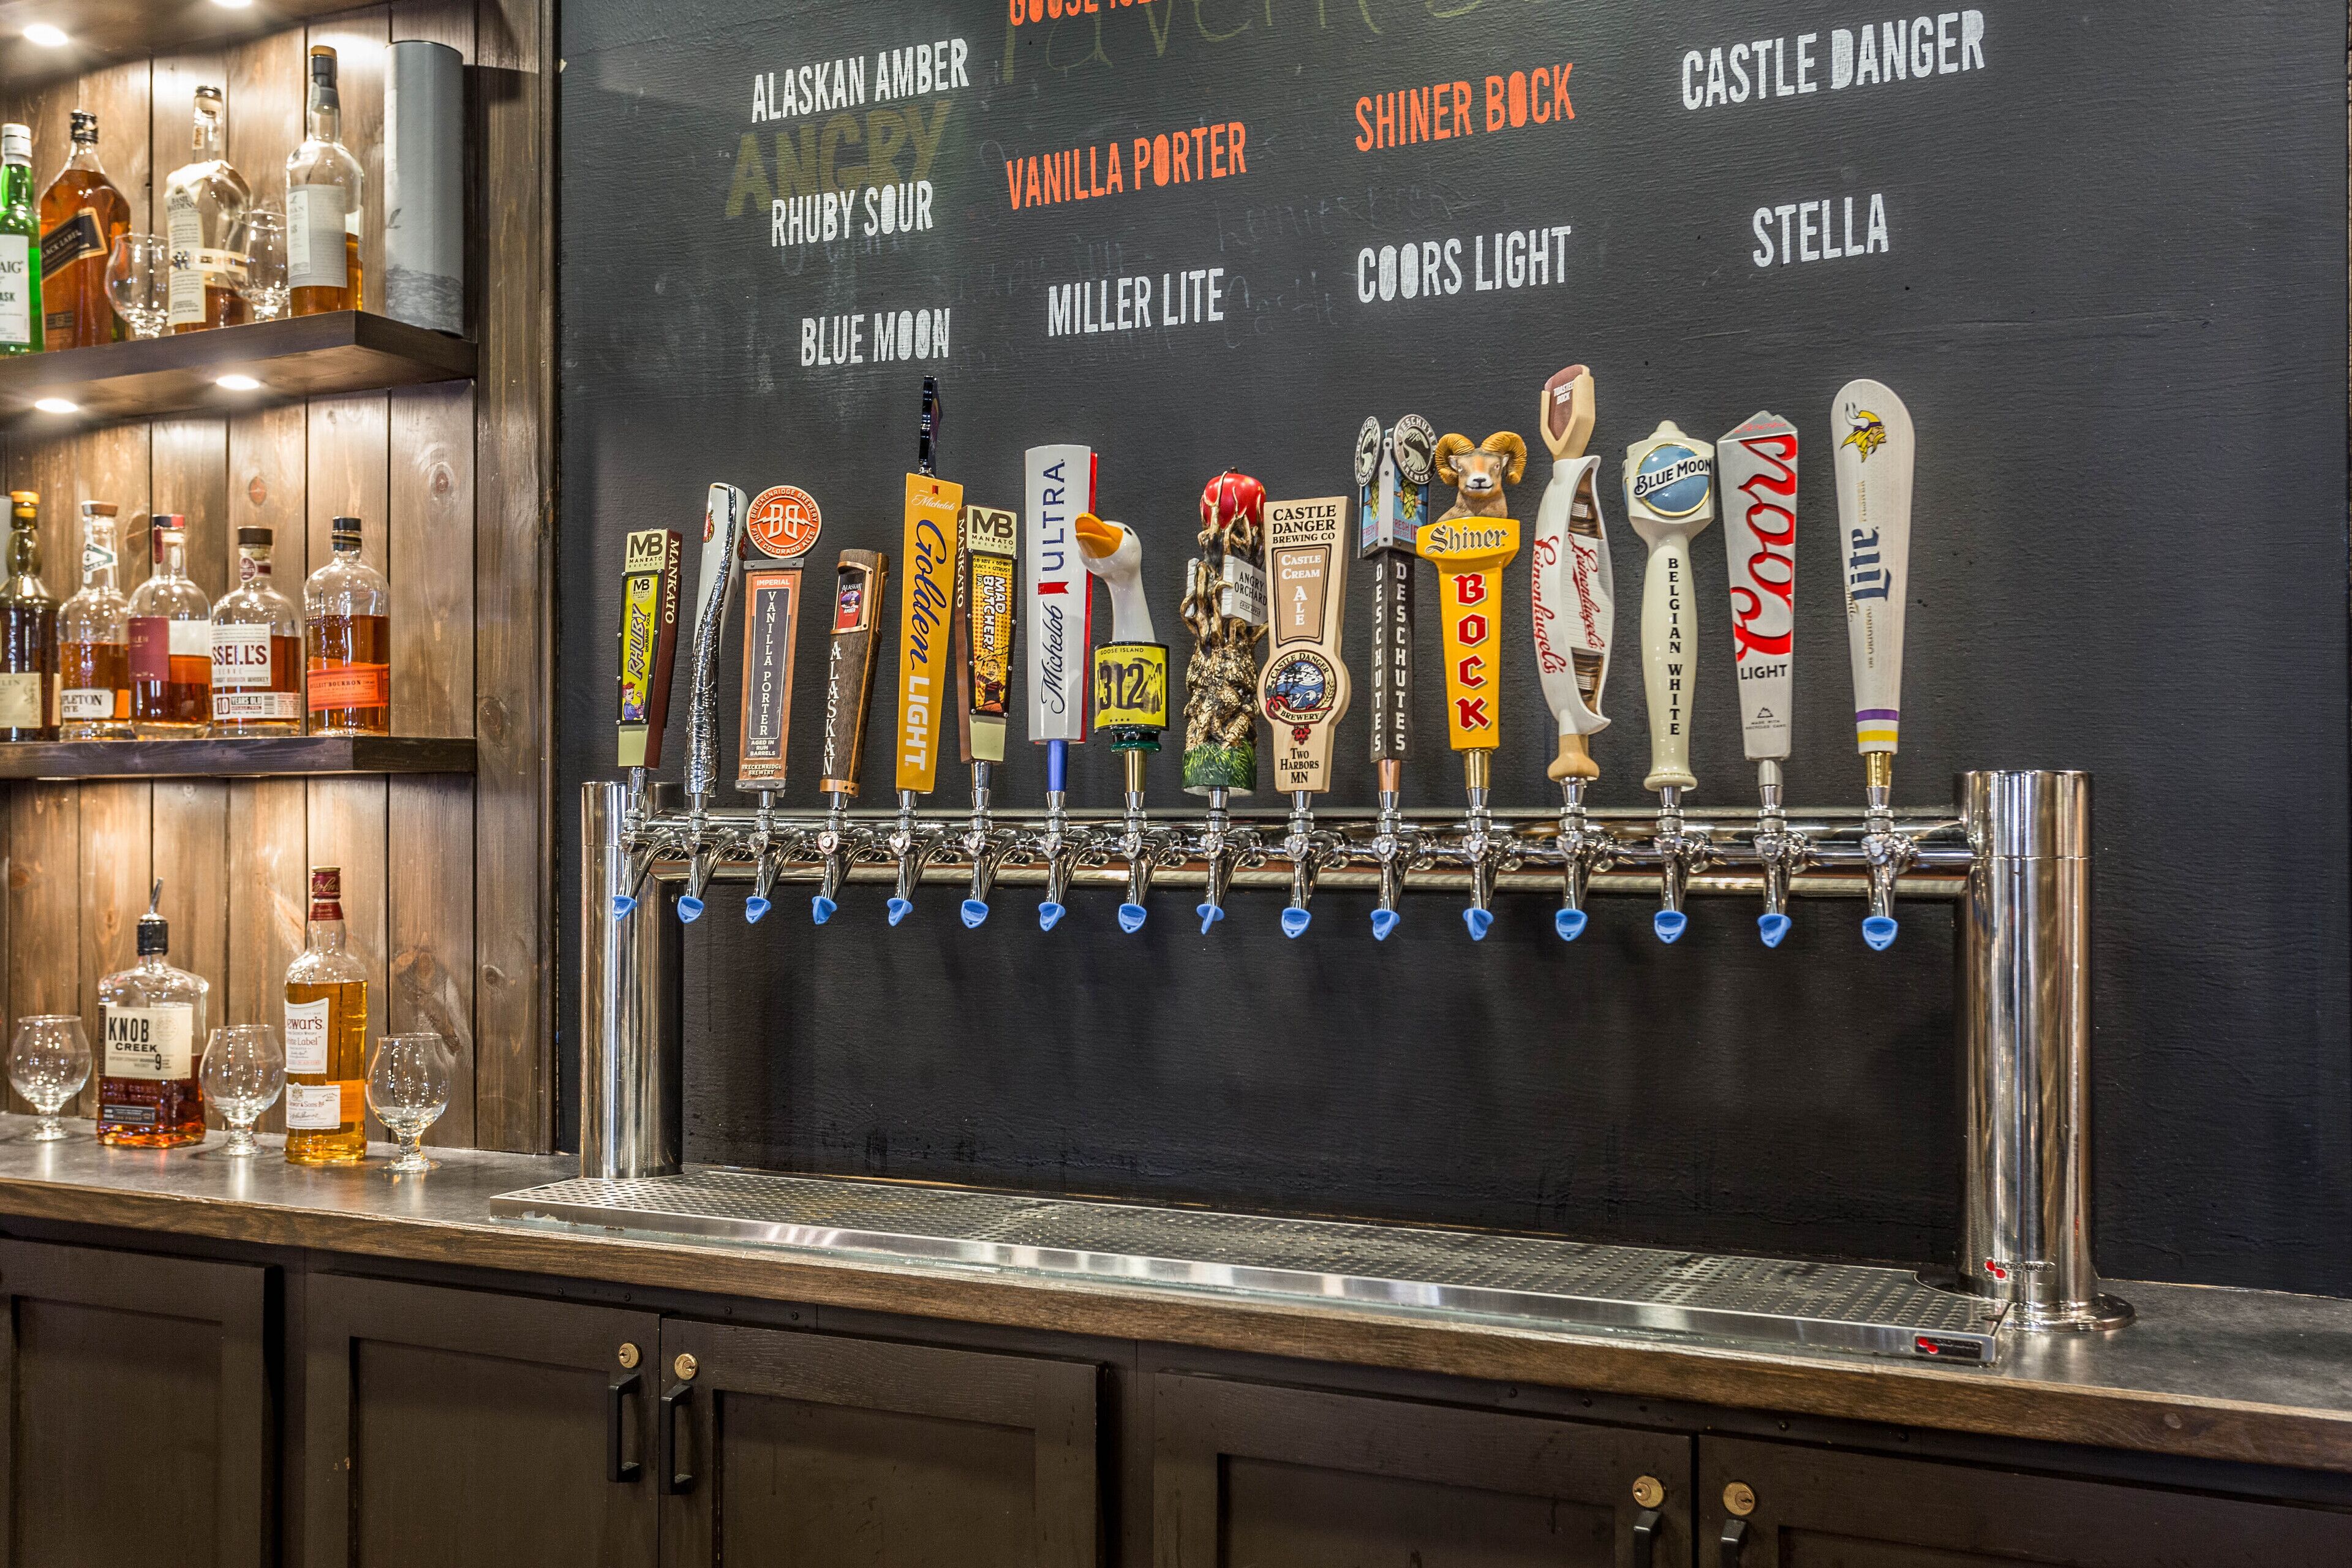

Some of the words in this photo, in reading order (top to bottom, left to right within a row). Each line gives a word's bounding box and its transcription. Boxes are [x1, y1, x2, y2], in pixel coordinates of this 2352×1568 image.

[1682, 32, 1817, 110] CASTLE
[1831, 9, 1985, 89] DANGER
[752, 56, 865, 123] ALASKAN
[875, 38, 969, 102] AMBER
[1355, 81, 1472, 151] SHINER
[1485, 63, 1575, 132] BOCK
[1006, 143, 1123, 209] VANILLA
[1134, 122, 1247, 190] PORTER
[772, 189, 856, 247] RHUBY
[864, 180, 933, 236] SOUR
[1752, 194, 1889, 267] STELLA
[1357, 238, 1462, 303] COORS
[1476, 225, 1571, 291] LIGHT
[1048, 276, 1152, 337] MILLER
[1163, 268, 1224, 326] LITE
[802, 315, 864, 366] BLUE
[873, 308, 950, 362] MOON
[1634, 468, 1673, 496] BLUE
[1677, 459, 1711, 478] MOON
[751, 489, 796, 519] BRECKENRIDGE
[797, 492, 818, 522] BREWERY
[911, 494, 955, 511] Michelob
[1042, 462, 1065, 571] ULTRA
[1273, 505, 1336, 521] CASTLE
[751, 528, 763, 545] FINE
[762, 544, 801, 554] COLORADO
[802, 530, 815, 548] ALES
[971, 535, 1014, 545] MANKATO
[972, 509, 1014, 538] MB
[1273, 519, 1336, 535] DANGER
[1273, 533, 1318, 544] BREWING
[1425, 524, 1509, 554] Shiner
[630, 533, 663, 559] MB
[971, 541, 1014, 550] BREWERY
[665, 538, 679, 624] MANKATO
[1239, 571, 1264, 592] ANGRY
[1849, 528, 1891, 602] Lite
[633, 579, 650, 592] MB
[841, 583, 862, 594] ALASKAN
[910, 519, 947, 671] Golden
[995, 576, 1006, 614] MAD
[1234, 582, 1267, 606] ORCHARD
[982, 576, 995, 652] BUTCHER!
[1251, 607, 1261, 616] APPLE
[1293, 586, 1308, 626] ALE
[1668, 558, 1682, 654] BELGIAN
[628, 603, 646, 681] RHUBY
[763, 591, 776, 666] VANILLA
[1041, 601, 1065, 715] Michelob
[1395, 562, 1407, 752] DESCHUTES
[1453, 573, 1491, 732] BOCK
[1099, 663, 1144, 710] 312
[1741, 664, 1788, 680] LIGHT
[217, 698, 229, 715] 10
[759, 672, 772, 736] PORTER
[823, 641, 842, 775] ALASKAN
[1280, 709, 1320, 720] BREWERY
[1668, 663, 1683, 736] WHITE
[904, 675, 930, 771] LIGHT
[1291, 772, 1308, 783] MN
[109, 1017, 149, 1042] KNOB
[116, 1042, 158, 1053] CREEK
[297, 1037, 318, 1046] Label
[155, 1054, 162, 1070] 9
[1995, 1262, 2023, 1270] MICRO
